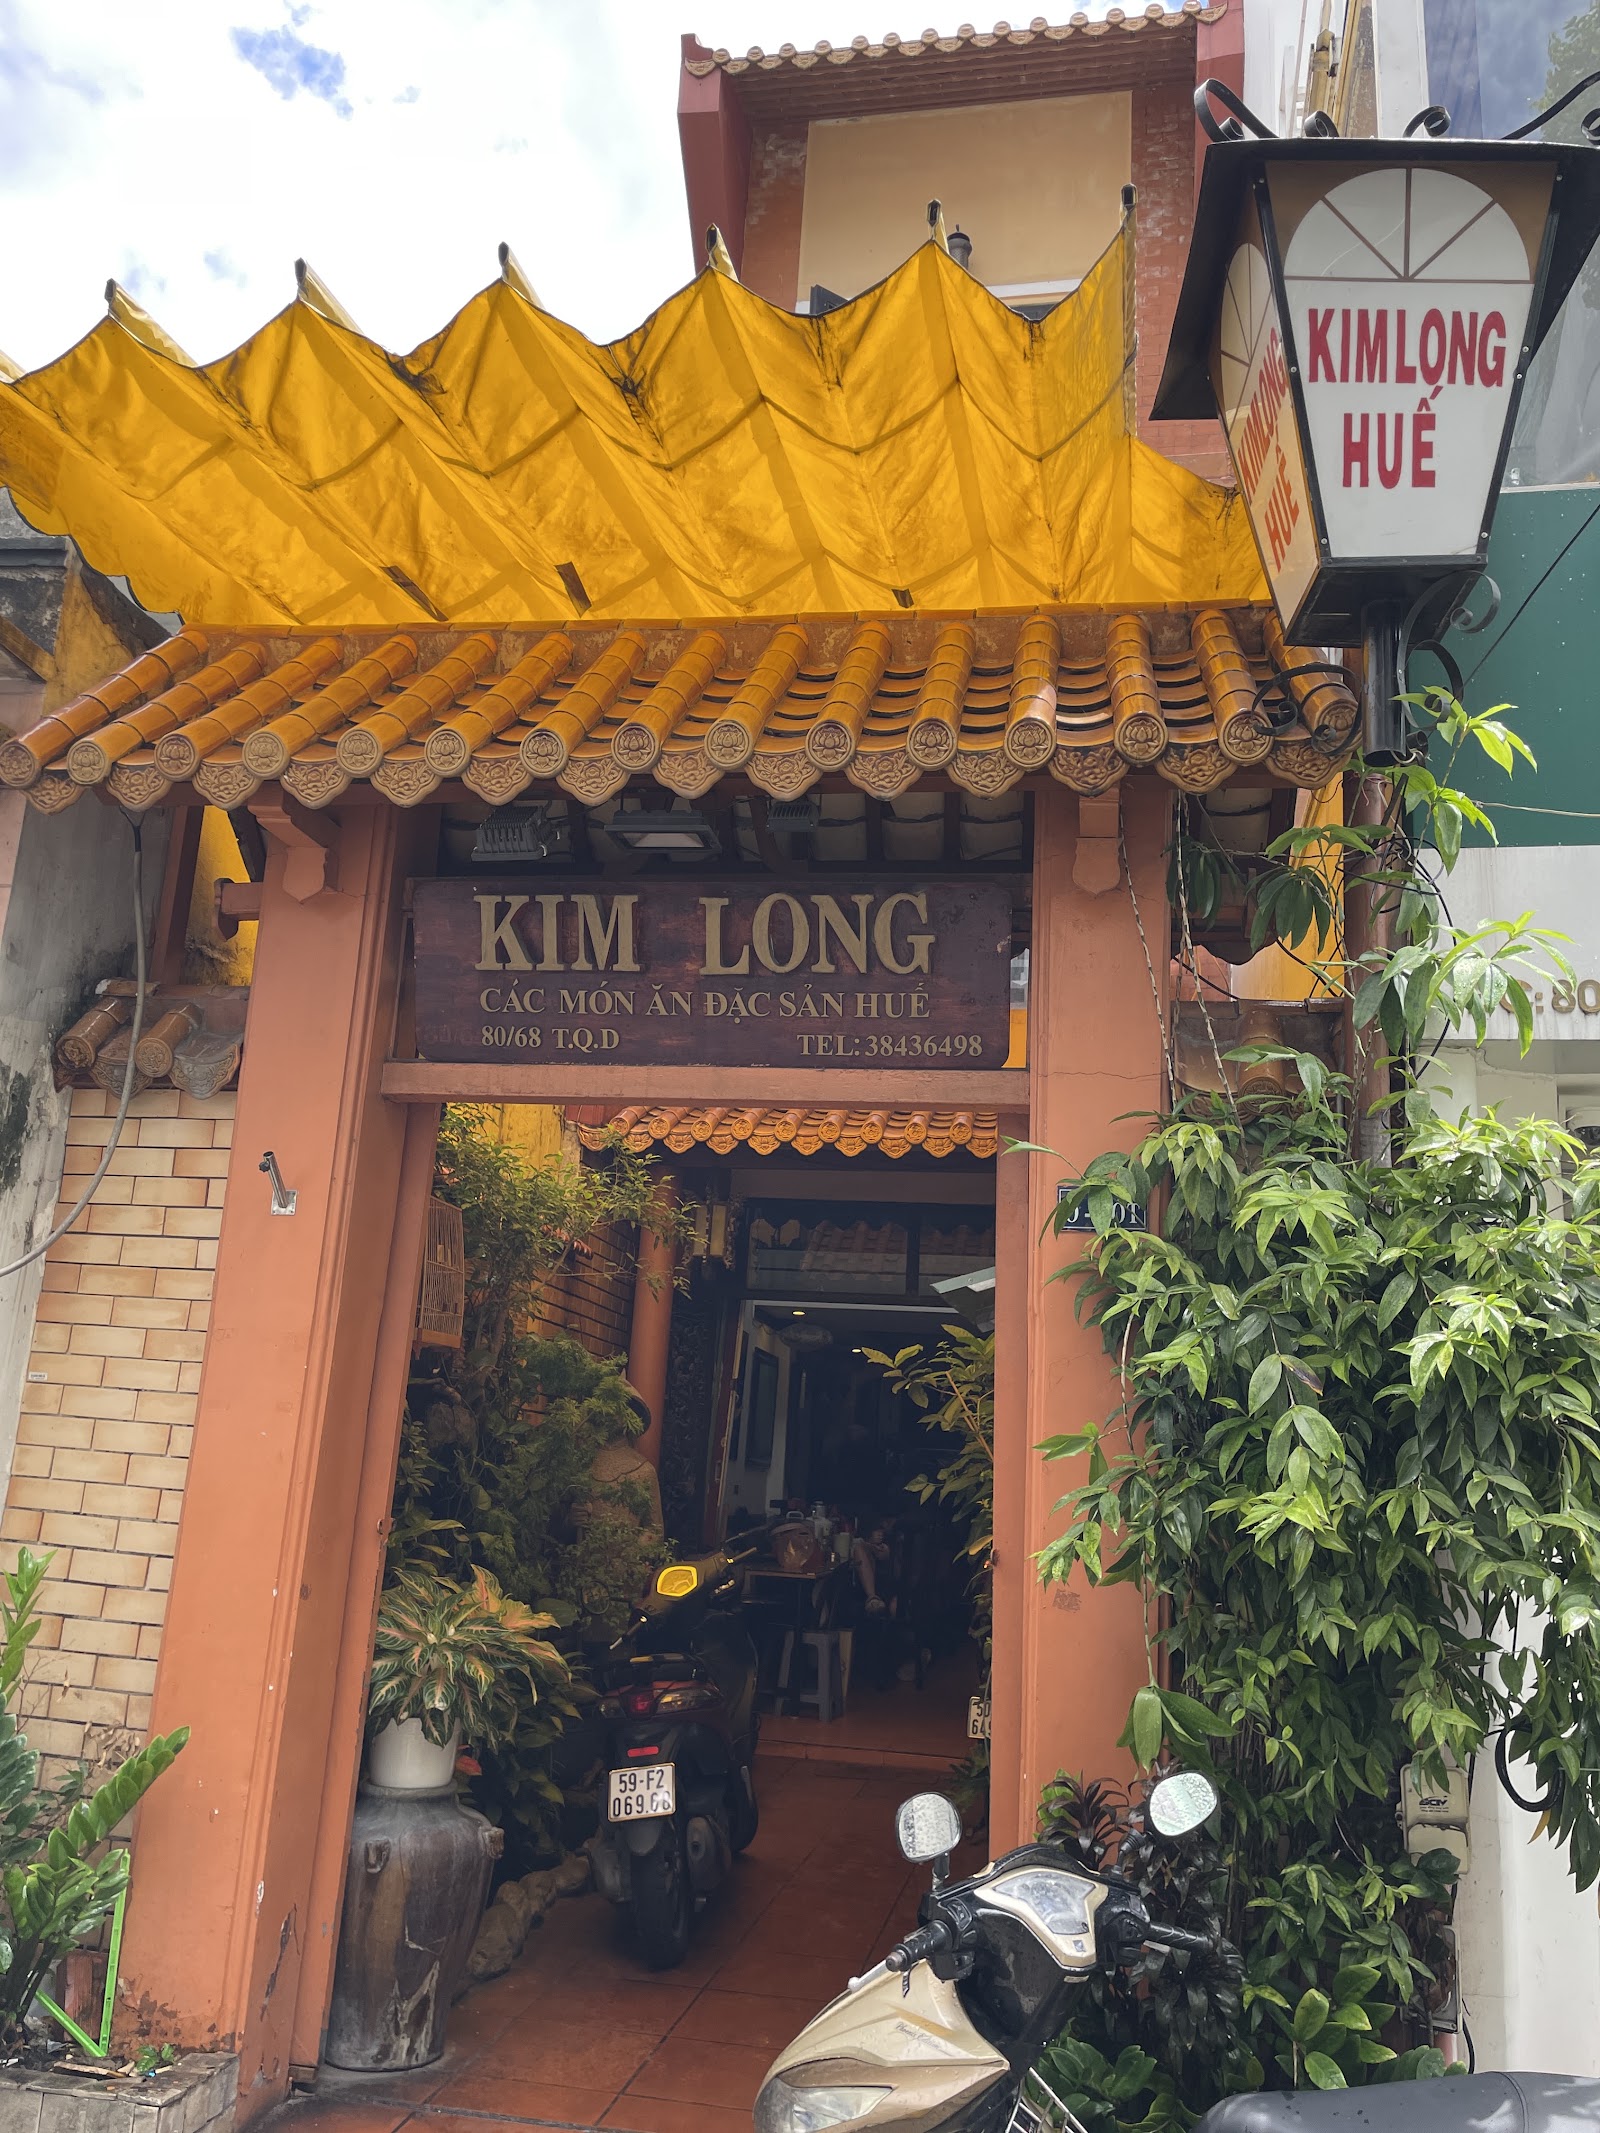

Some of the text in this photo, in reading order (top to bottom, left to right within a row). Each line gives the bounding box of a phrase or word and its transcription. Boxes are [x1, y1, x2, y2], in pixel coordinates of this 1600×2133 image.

[1342, 385, 1444, 489] HUẾ
[1264, 420, 1300, 573] HUẾ
[473, 892, 936, 975] KIM LONG
[479, 978, 931, 1024] CÁC MÓN ĂN ĐẶC SẢN HUẾ
[481, 1025, 542, 1048] 80/68
[551, 1028, 620, 1053] T.Q.D
[612, 1790, 672, 1817] 069.68
[618, 1768, 665, 1794] 59-F2
